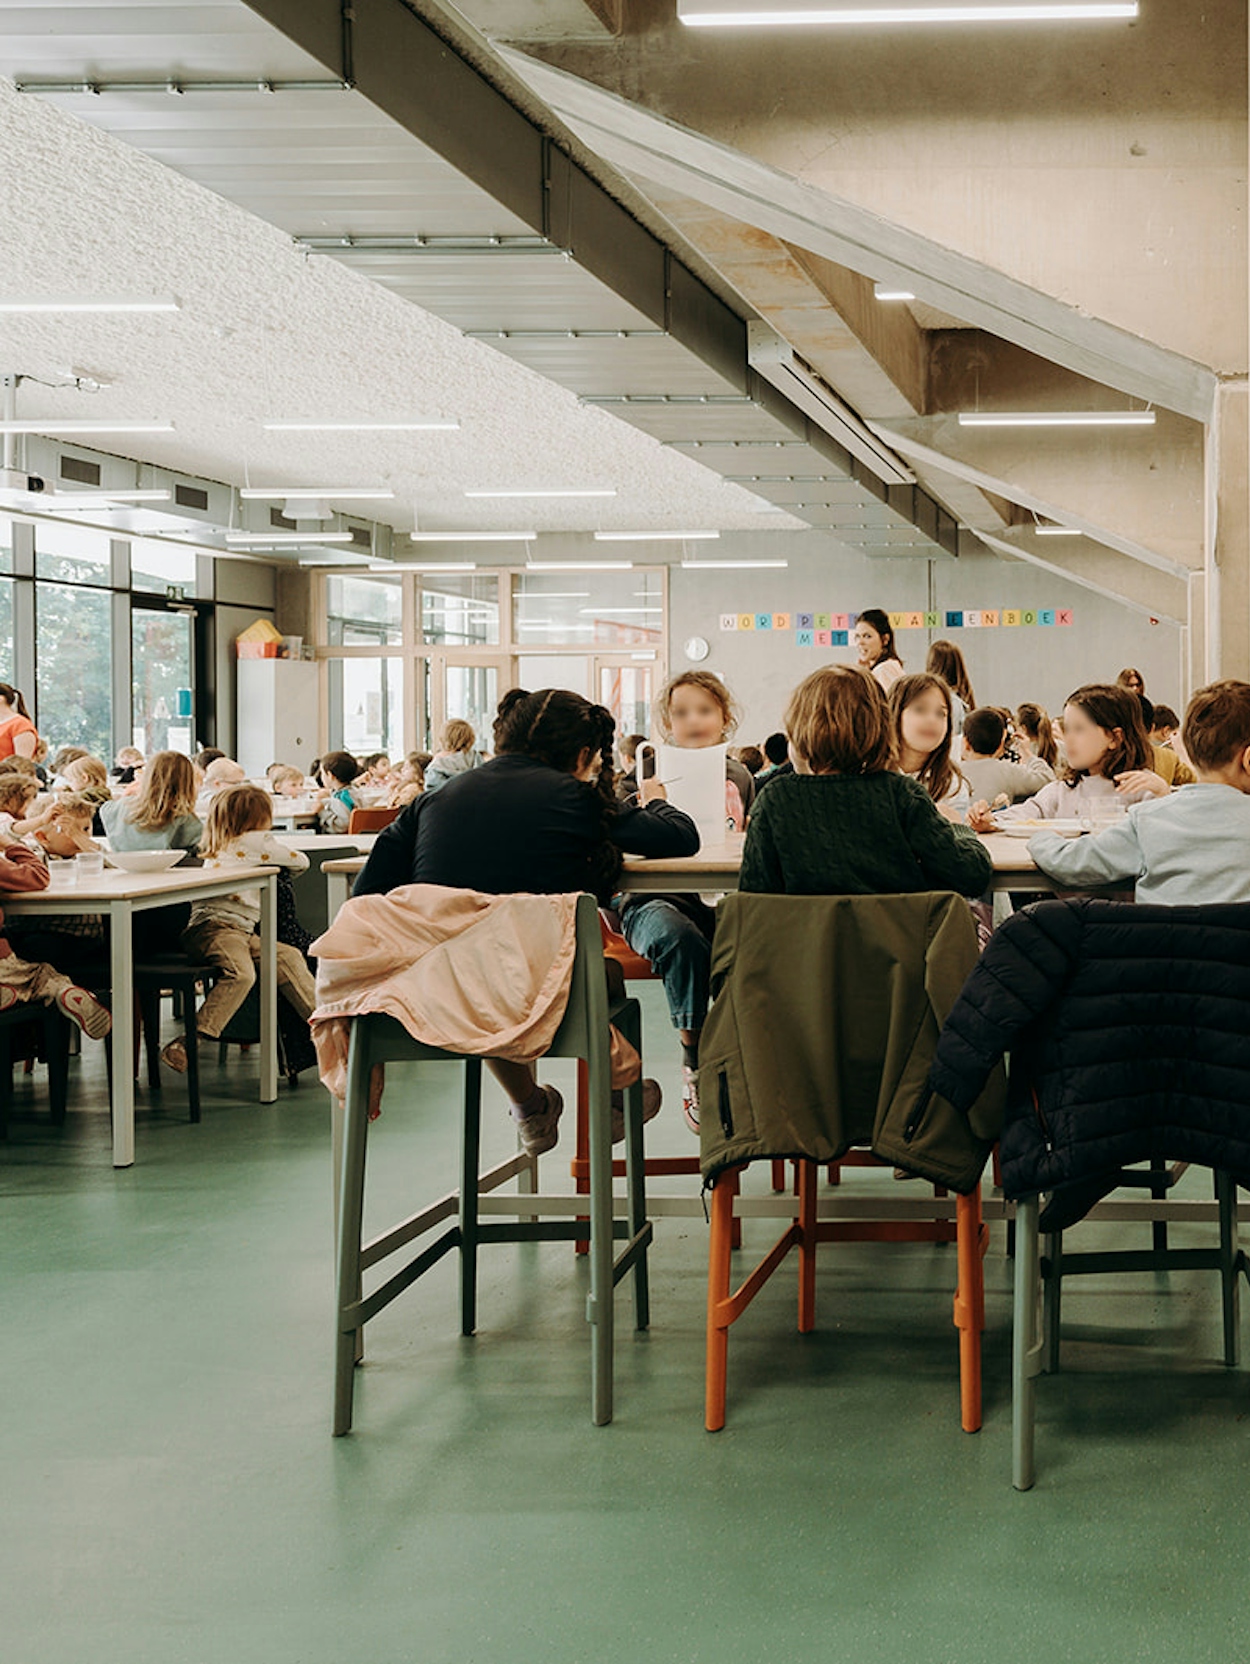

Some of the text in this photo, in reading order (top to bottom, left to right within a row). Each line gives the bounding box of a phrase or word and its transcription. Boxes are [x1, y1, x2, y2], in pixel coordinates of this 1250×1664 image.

[722, 611, 1069, 628] WORD PET VAN EEN BOEK
[799, 632, 844, 645] MET
